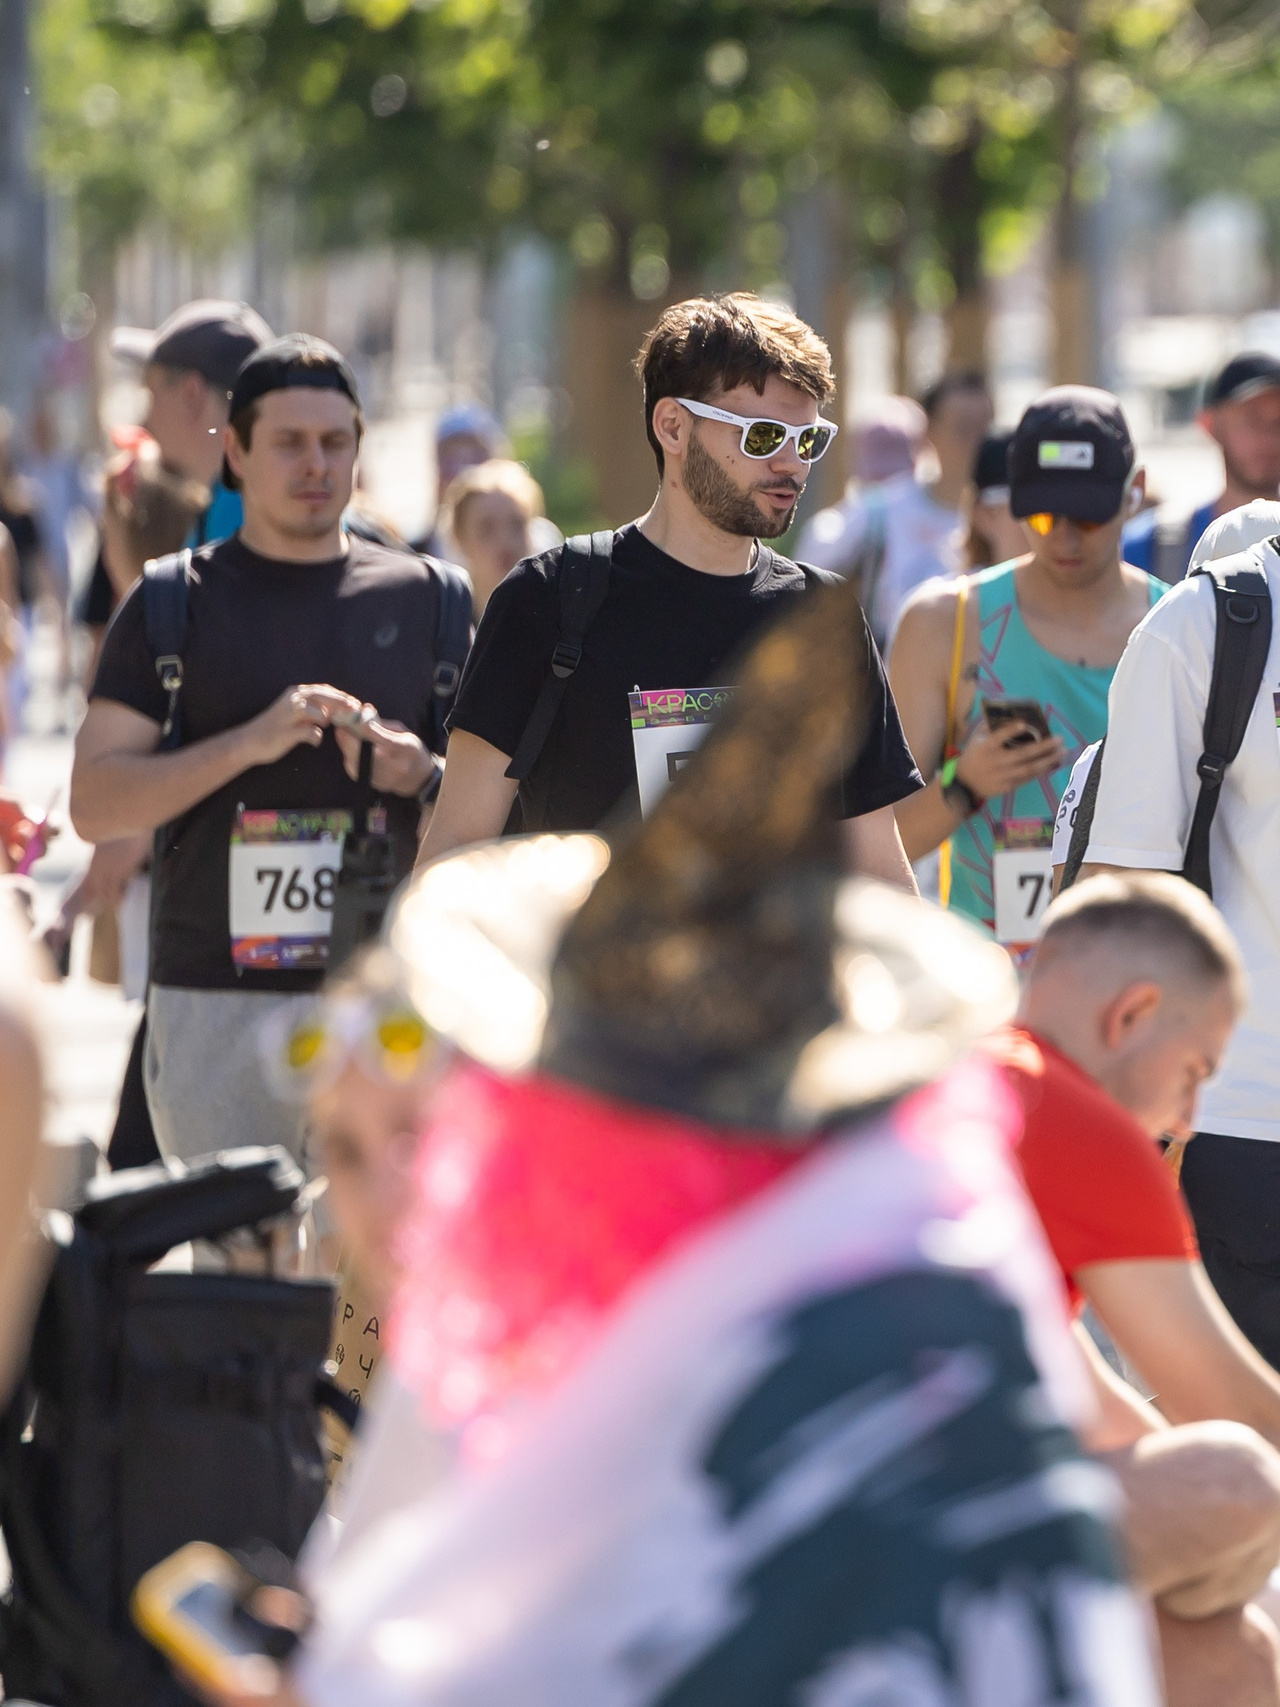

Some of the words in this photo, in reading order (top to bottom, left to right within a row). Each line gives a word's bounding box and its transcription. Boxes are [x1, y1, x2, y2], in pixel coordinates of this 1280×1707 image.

[256, 866, 336, 914] 768
[1018, 872, 1053, 918] 7
[335, 1297, 380, 1340] РА
